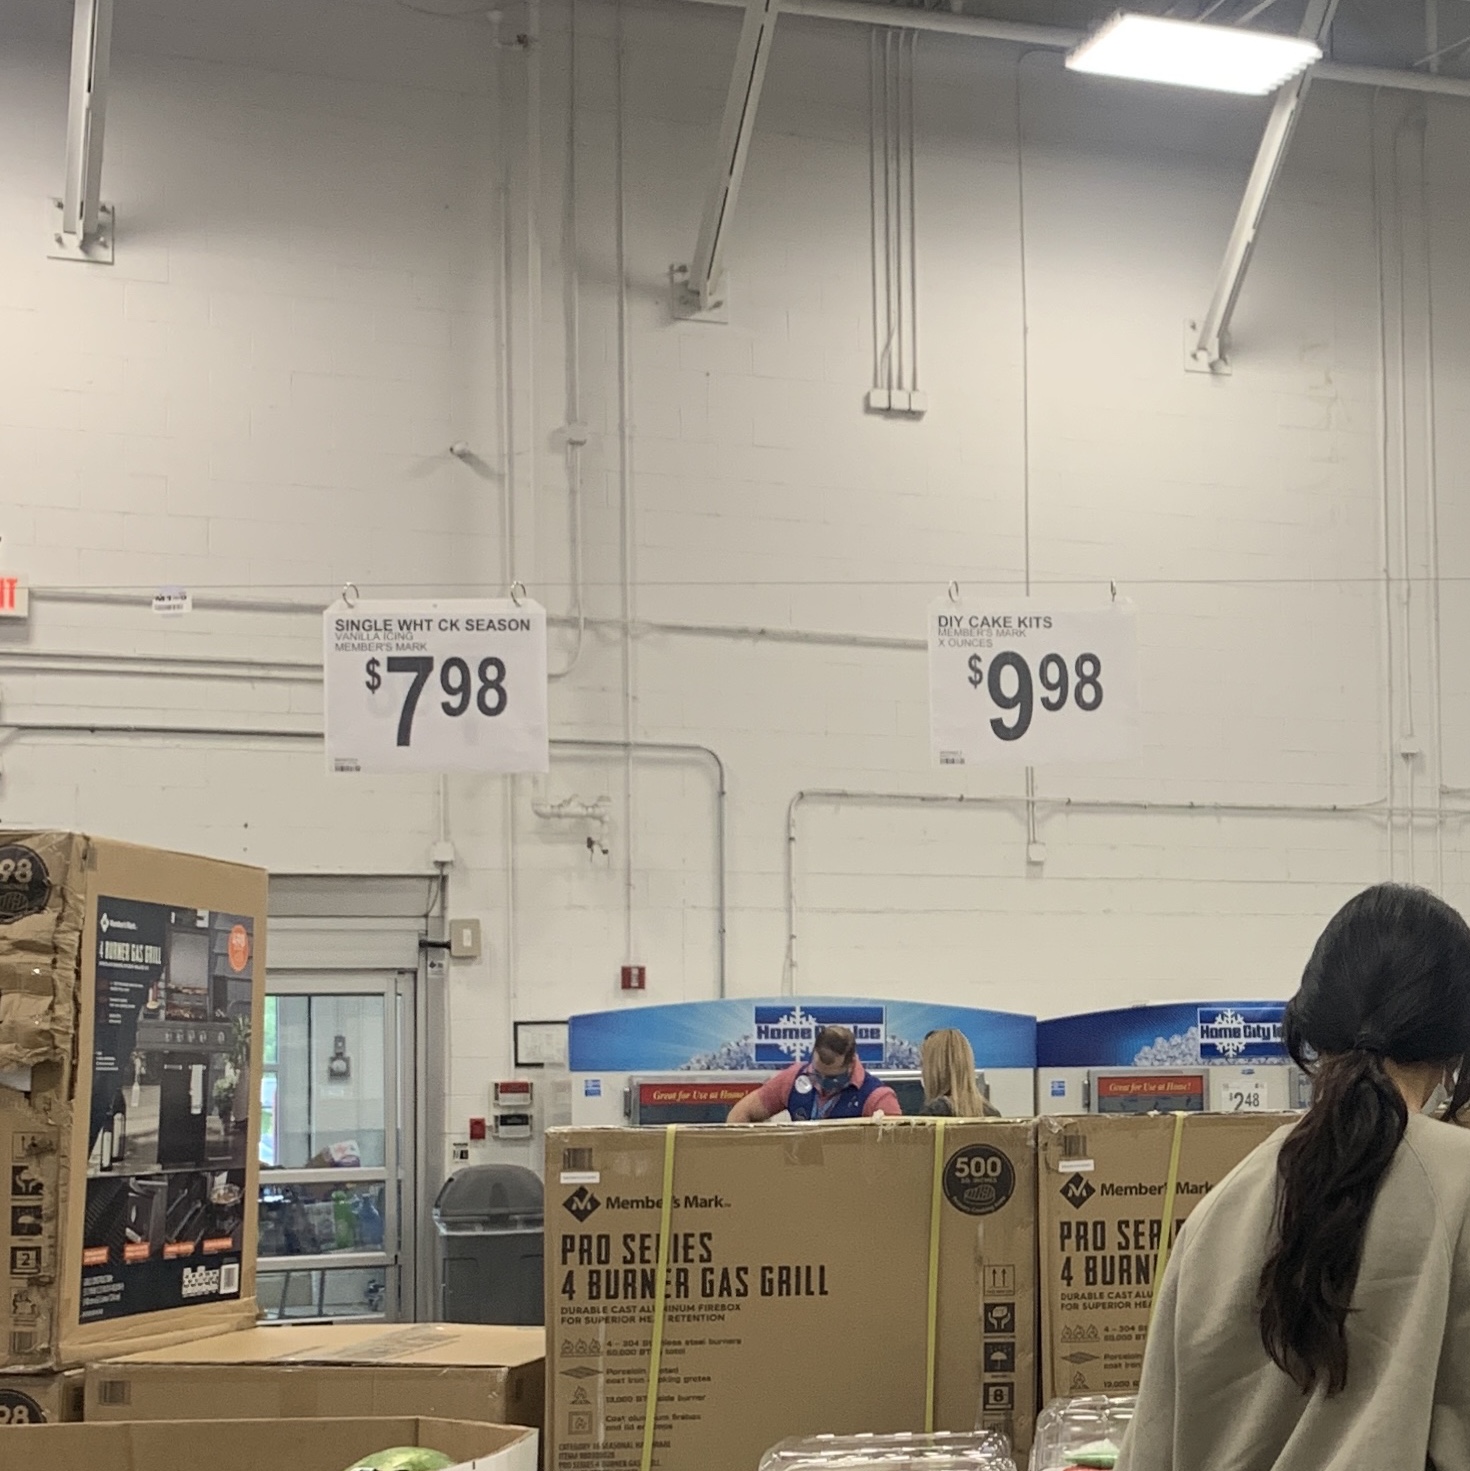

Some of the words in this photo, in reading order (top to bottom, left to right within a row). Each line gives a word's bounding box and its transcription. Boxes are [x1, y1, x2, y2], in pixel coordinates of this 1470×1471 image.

[335, 619, 392, 631] SINGLE
[398, 619, 433, 631] WHT
[438, 619, 460, 631] CK
[465, 619, 531, 631] SEASON
[938, 615, 964, 628] DIY
[968, 615, 1013, 628] CAKE
[1018, 616, 1053, 628] KITS
[335, 632, 380, 641] VANILLA
[383, 632, 414, 641] ICING
[938, 628, 994, 637] MEMBER'S
[995, 628, 1027, 637] MARK
[335, 642, 393, 651] MEMBER'S
[395, 642, 428, 651] MARK
[938, 638, 946, 648] X
[948, 638, 994, 648] OUNCES
[365, 656, 508, 747] $798
[967, 650, 1104, 742] $998
[756, 1024, 812, 1040] Home
[1200, 1025, 1241, 1039] Home
[1243, 1024, 1271, 1041] City
[954, 1156, 1002, 1178] 500
[1100, 1182, 1168, 1196] Member'
[684, 1195, 724, 1209] Mark
[1060, 1220, 1106, 1251] PRO
[562, 1233, 611, 1266] PRO
[21, 1252, 30, 1266] 2
[1060, 1256, 1074, 1287] 4
[1085, 1254, 1158, 1286] BURN
[561, 1270, 576, 1300] 4
[701, 1267, 749, 1298] GAS
[760, 1265, 829, 1297] GRILL
[1060, 1292, 1104, 1301] DURABLE
[1107, 1291, 1133, 1300] CAST
[560, 1305, 607, 1316] DURABLE
[611, 1304, 637, 1314] CAST
[698, 1302, 742, 1312] FIREBOX
[1061, 1302, 1079, 1311] FOR
[1082, 1301, 1132, 1311] SUPERIOR
[560, 1315, 581, 1325] FOR
[584, 1314, 636, 1324] SUPERIOR
[668, 1313, 725, 1323] RETENTION
